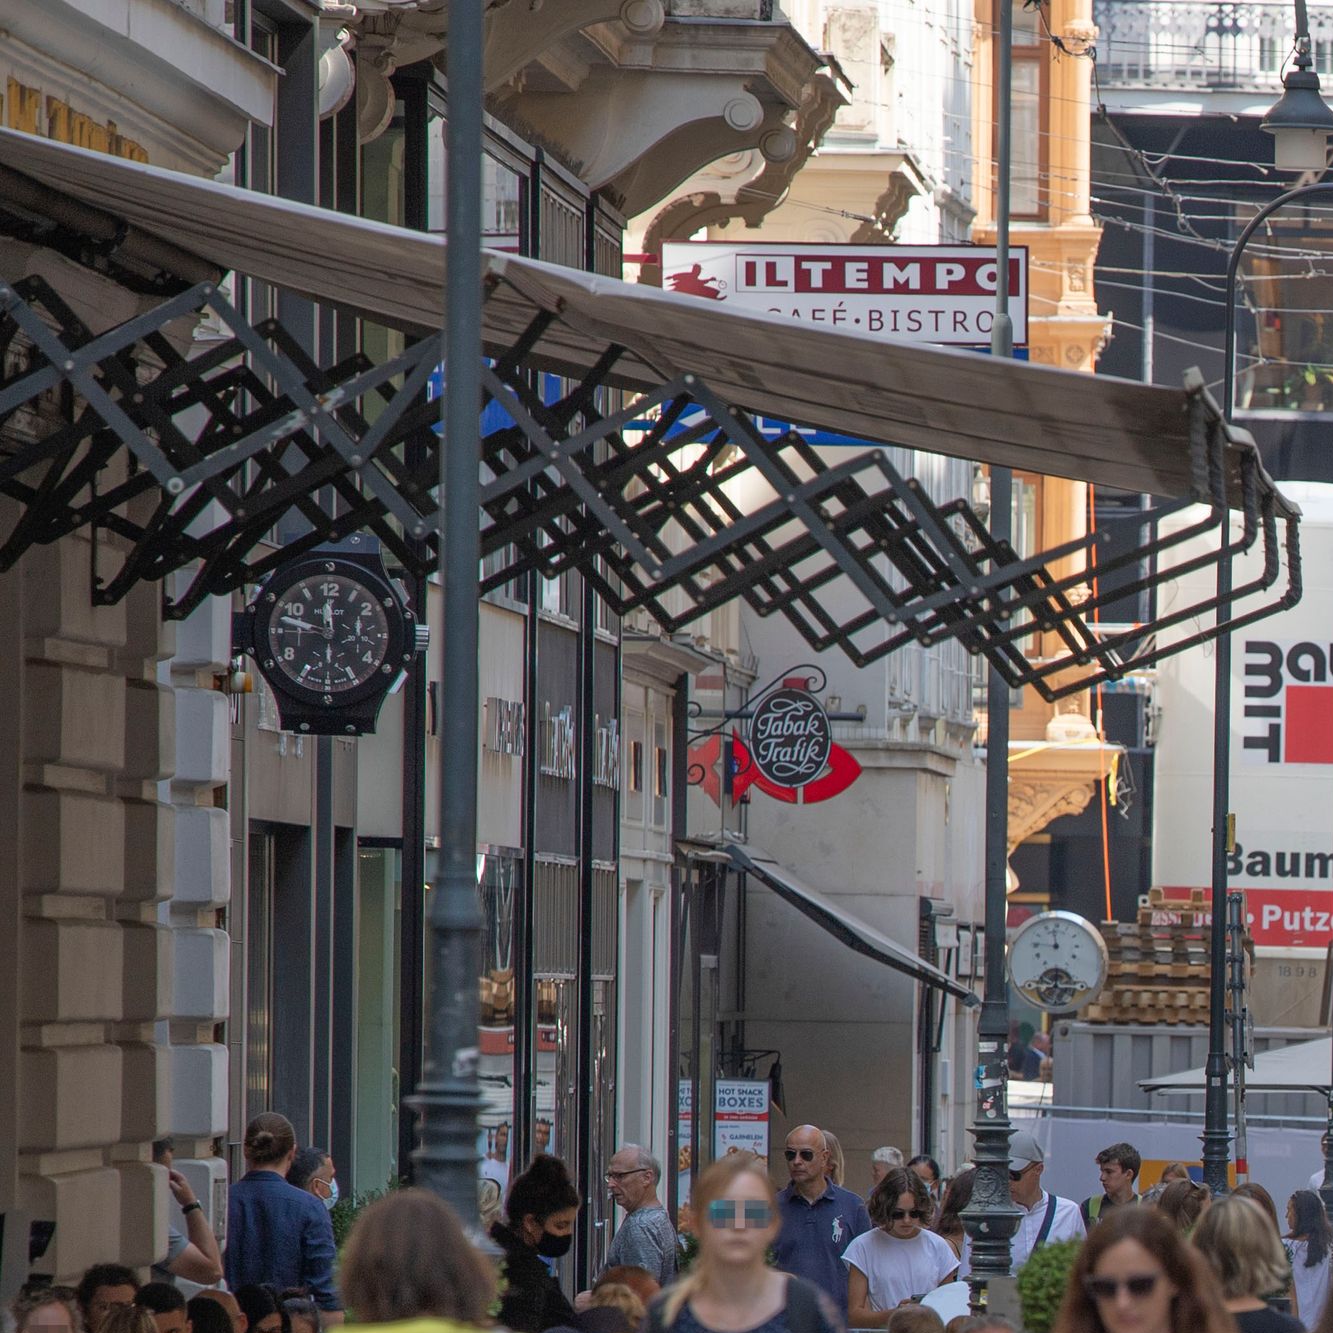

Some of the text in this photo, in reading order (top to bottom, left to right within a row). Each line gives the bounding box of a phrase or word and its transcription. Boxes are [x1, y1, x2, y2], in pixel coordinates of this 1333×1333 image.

[745, 261, 1009, 290] IL TEMPO
[768, 302, 994, 333] FÉ BISTRO
[320, 583, 339, 597] 12
[284, 602, 372, 616] 10 HULOT 2
[283, 647, 373, 665] 8 4
[757, 702, 824, 739] Tabak
[758, 737, 824, 765] Trafik
[718, 1088, 764, 1096] HOT SNACK
[718, 1096, 764, 1108] BOXES
